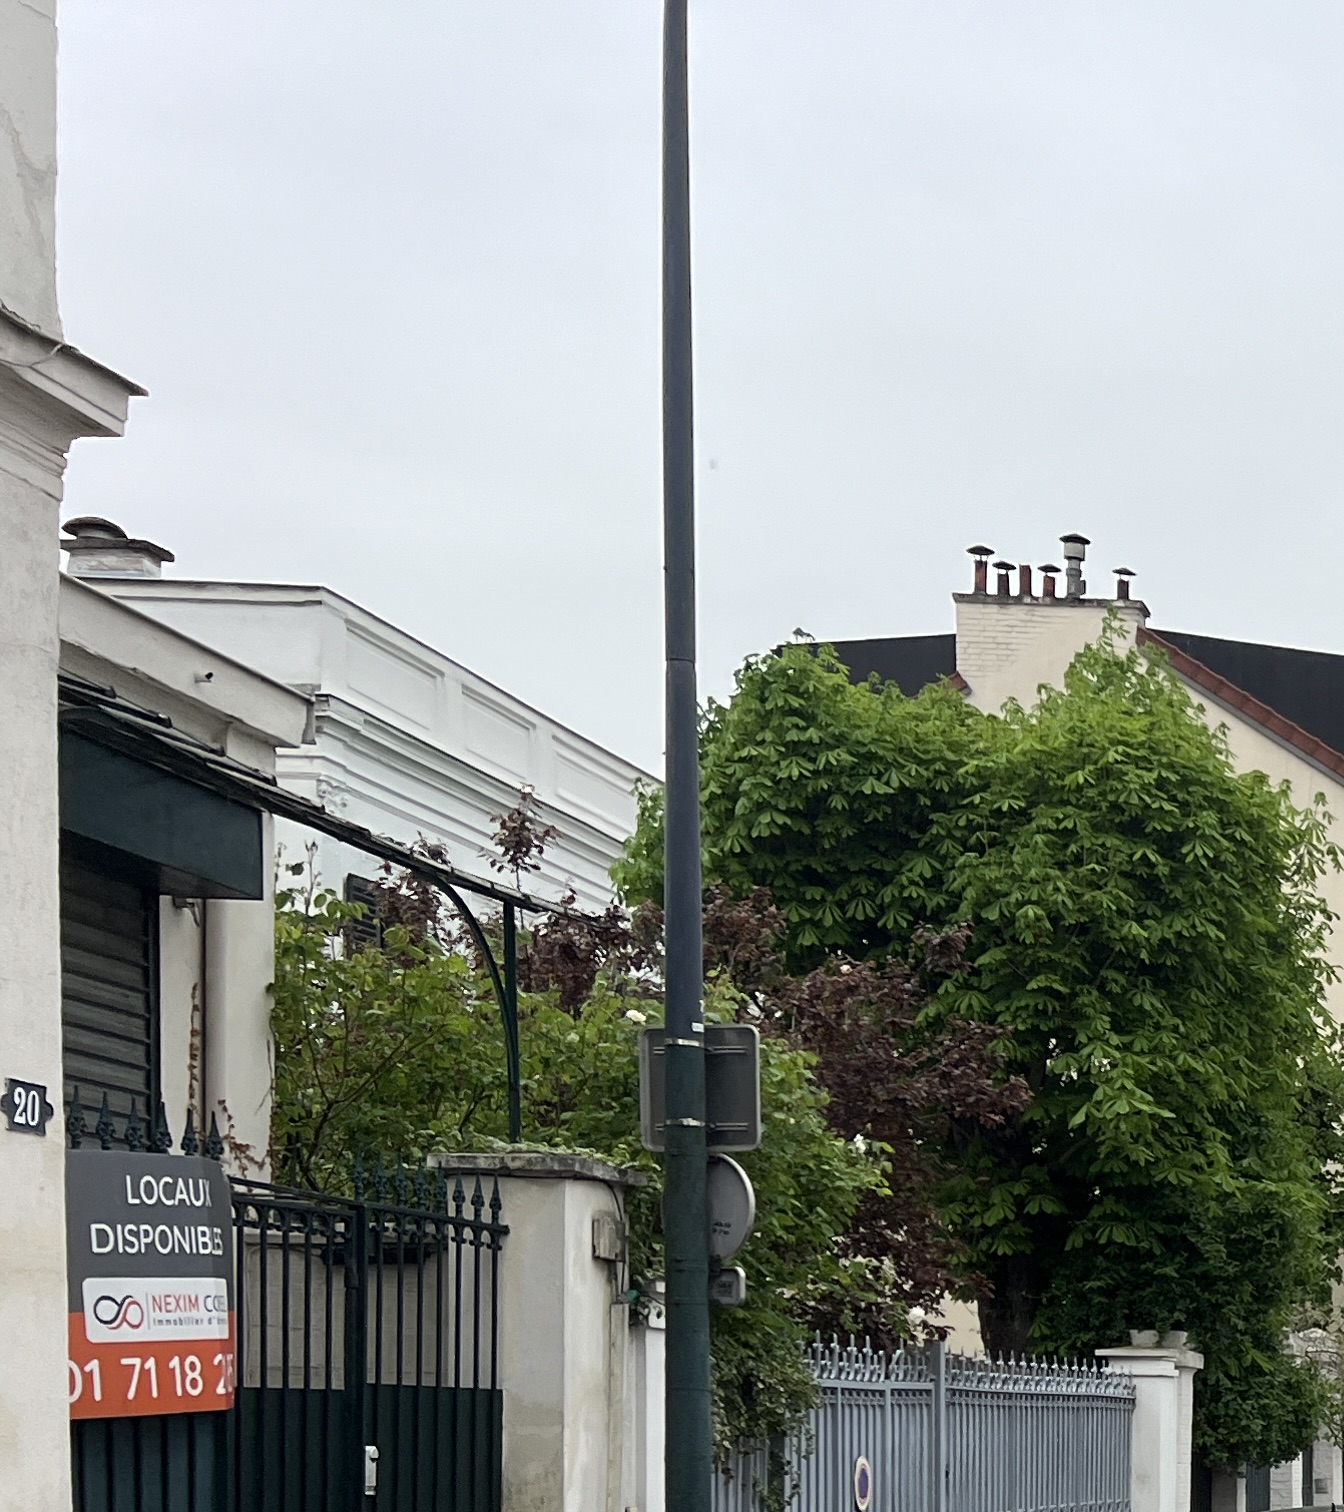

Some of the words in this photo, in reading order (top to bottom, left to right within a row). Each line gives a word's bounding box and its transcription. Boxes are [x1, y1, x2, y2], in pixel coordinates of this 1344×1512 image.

[13, 1086, 40, 1126] 20
[125, 1175, 212, 1207] LOCAUX
[152, 1294, 200, 1314] NEXIM
[120, 1356, 159, 1401] 71
[169, 1355, 204, 1396] 18
